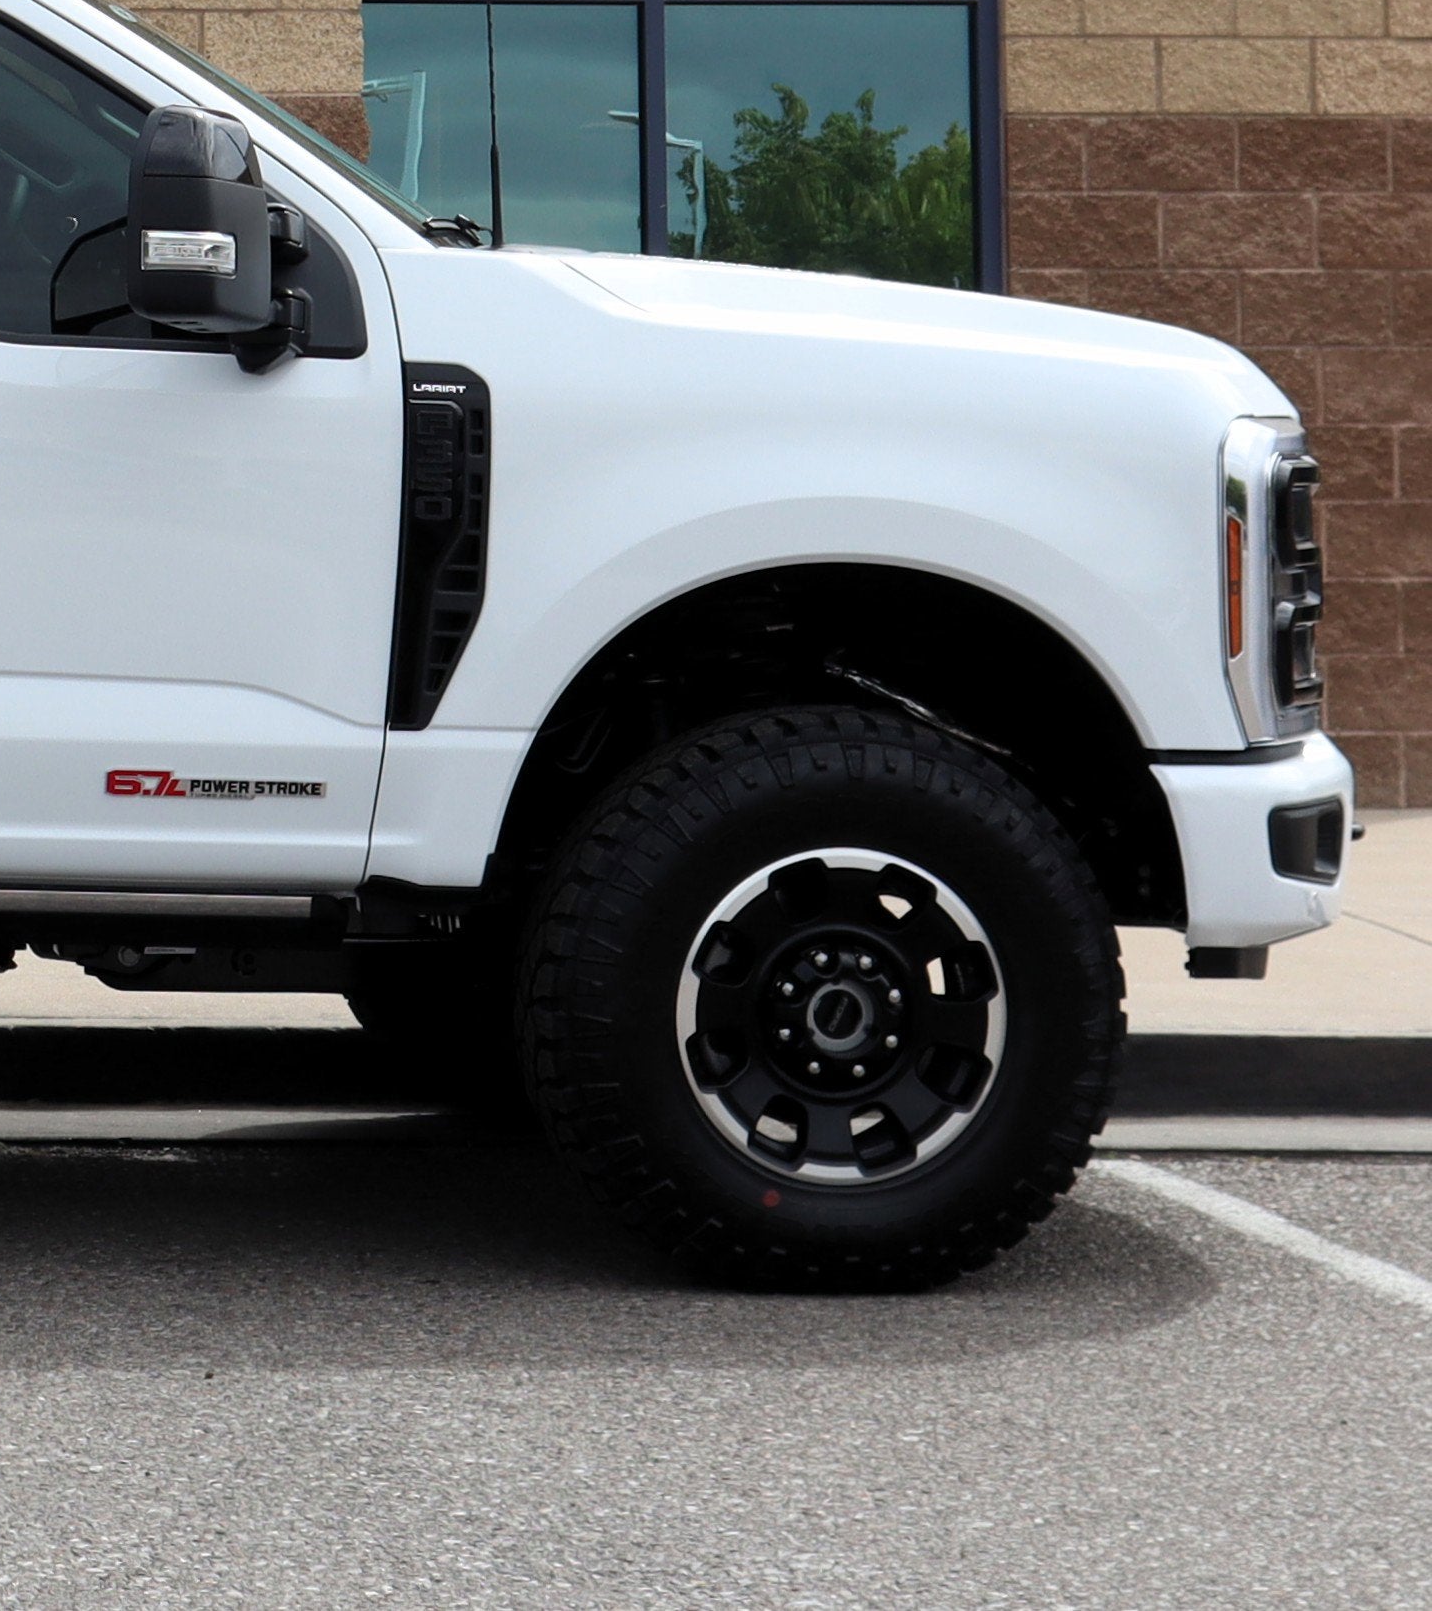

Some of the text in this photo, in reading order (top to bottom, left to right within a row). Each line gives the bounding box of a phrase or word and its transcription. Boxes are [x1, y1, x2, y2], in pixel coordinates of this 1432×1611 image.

[413, 383, 467, 394] LARIAT
[106, 770, 187, 797] 6.7L
[190, 779, 250, 794] POWER
[254, 781, 322, 796] STROKE
